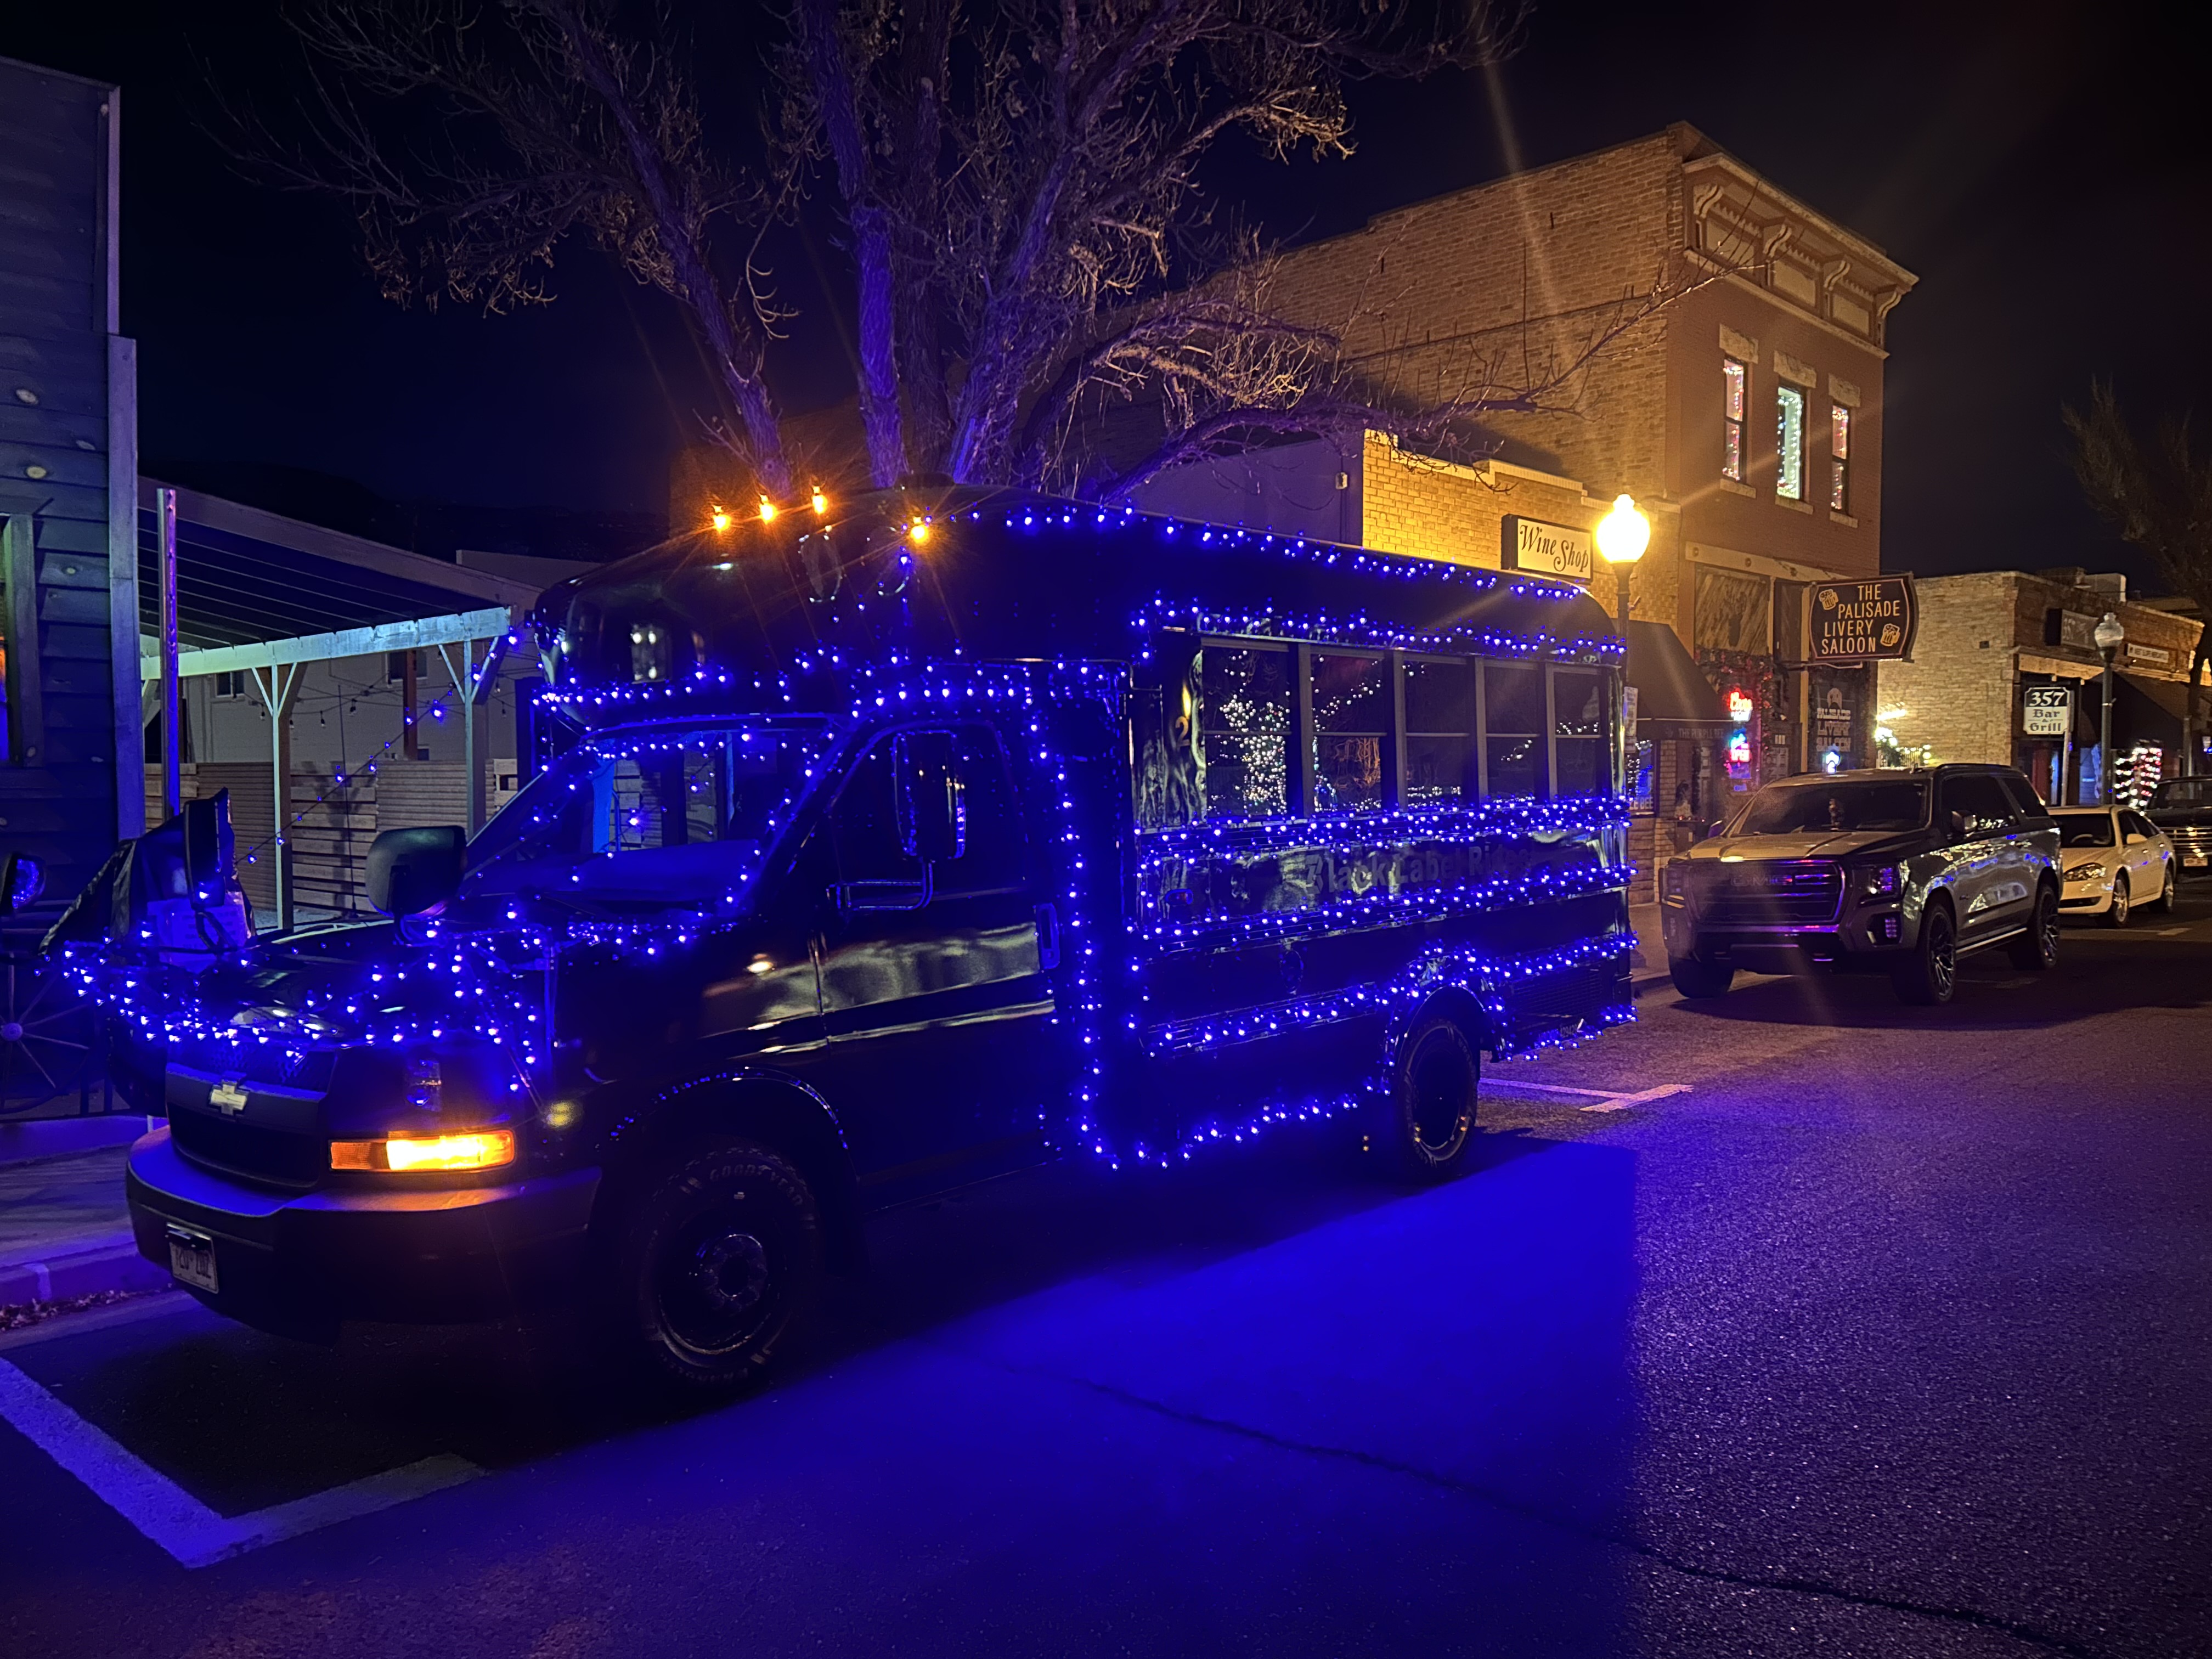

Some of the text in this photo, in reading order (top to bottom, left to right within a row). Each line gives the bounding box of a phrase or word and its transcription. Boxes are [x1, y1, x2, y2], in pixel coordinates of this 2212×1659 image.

[1520, 524, 1589, 572] Wine Shop
[1858, 584, 1881, 601] THE
[1838, 600, 1900, 619] PALISADE
[1824, 619, 1874, 637] LIVERY
[1821, 637, 1876, 654] SALOON
[2029, 690, 2065, 706] 357
[2033, 709, 2061, 718] Bar
[2028, 723, 2061, 731] Grill
[1305, 853, 1387, 894] Black
[1392, 847, 1462, 884] Label
[1731, 875, 1793, 887] GMC
